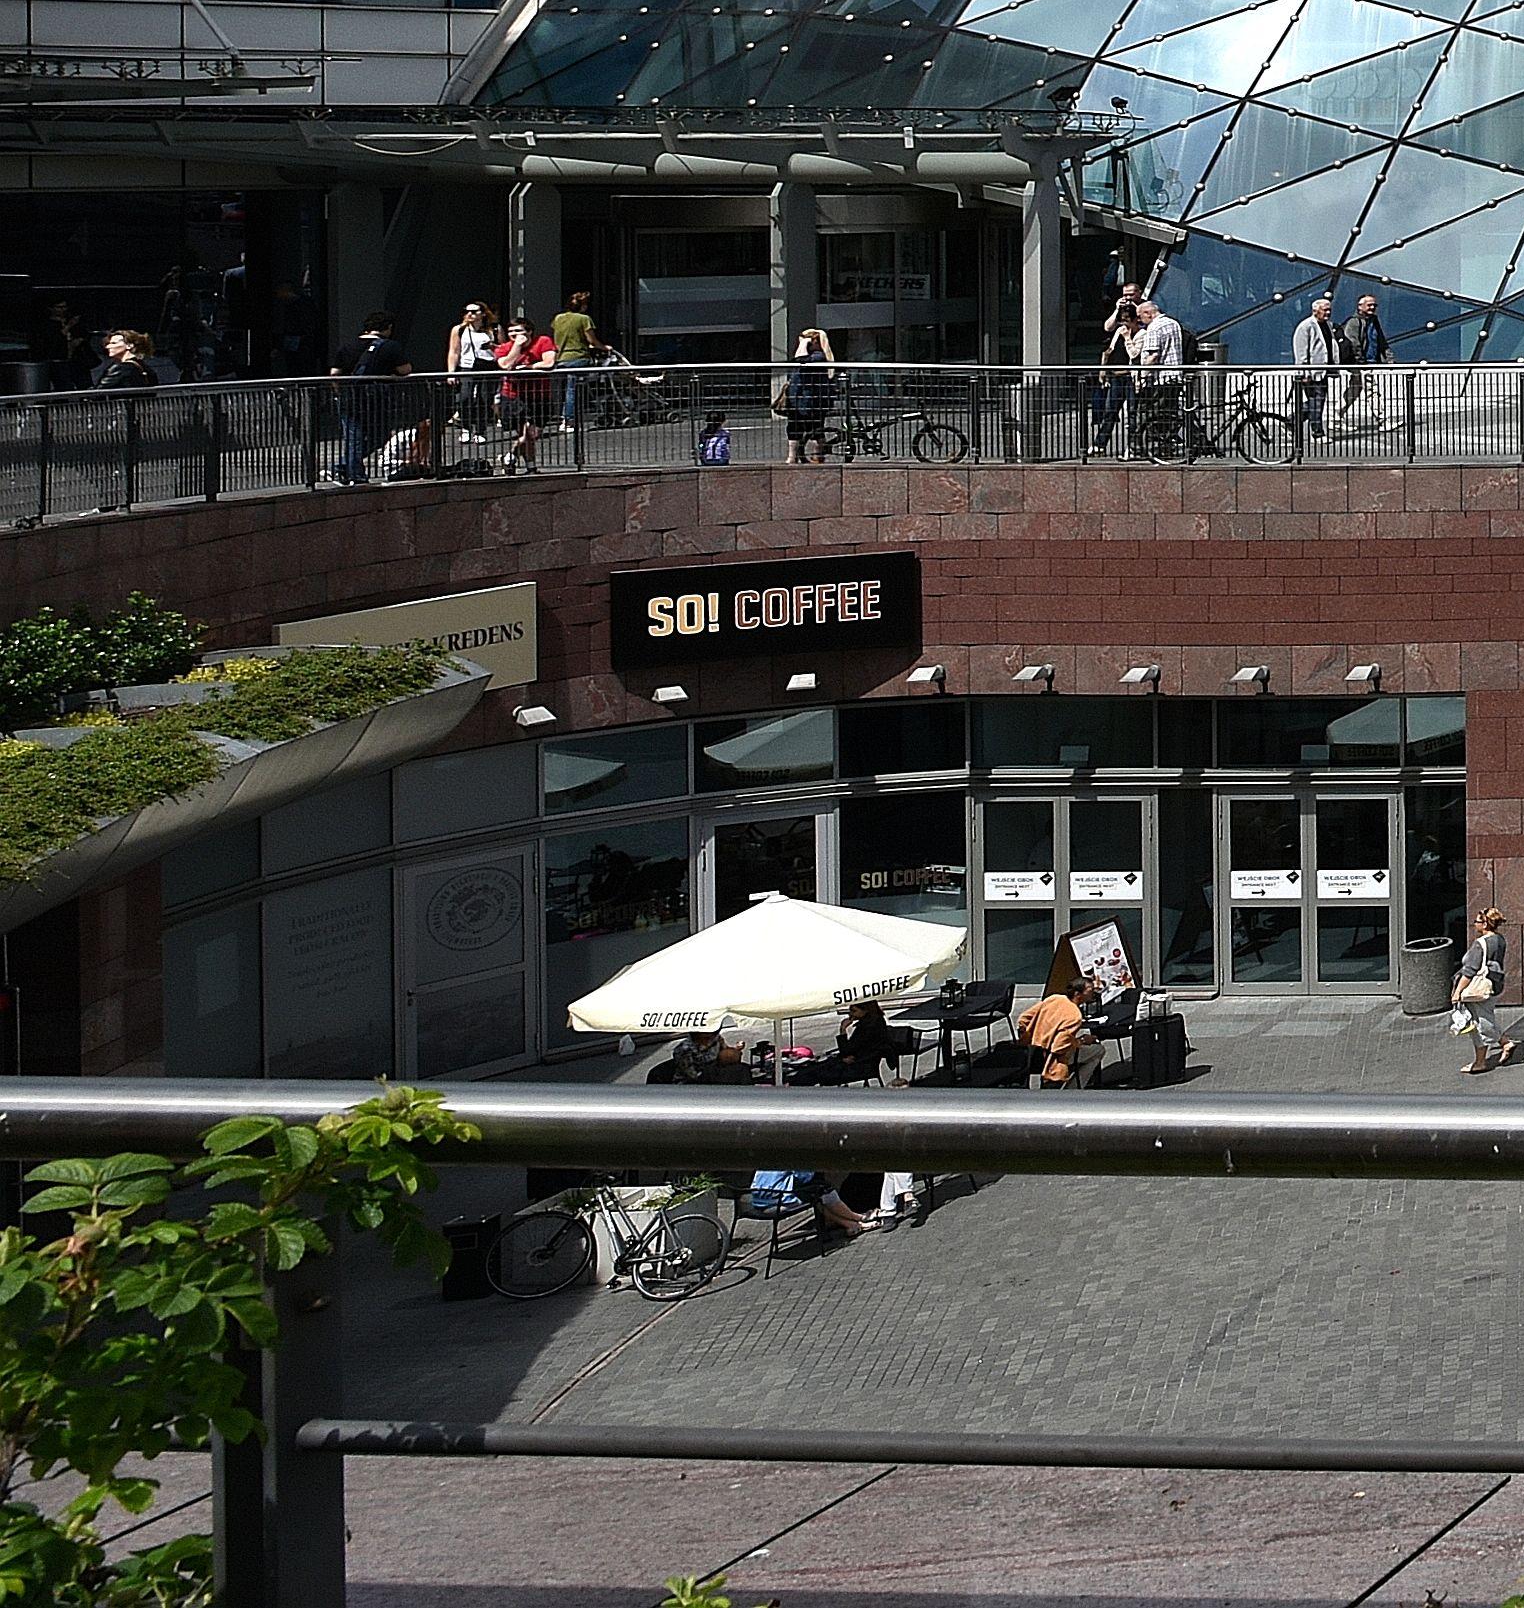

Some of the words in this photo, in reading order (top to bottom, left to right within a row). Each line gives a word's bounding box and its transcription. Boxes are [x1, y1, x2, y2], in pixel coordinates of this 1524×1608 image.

[647, 593, 720, 637] SO!
[734, 580, 882, 632] COFFEE
[861, 871, 888, 889] SO!
[832, 986, 858, 1007] SO!
[862, 973, 911, 1002] COFFEE
[640, 1013, 661, 1029] SO!
[664, 1011, 709, 1029] COFFEE
